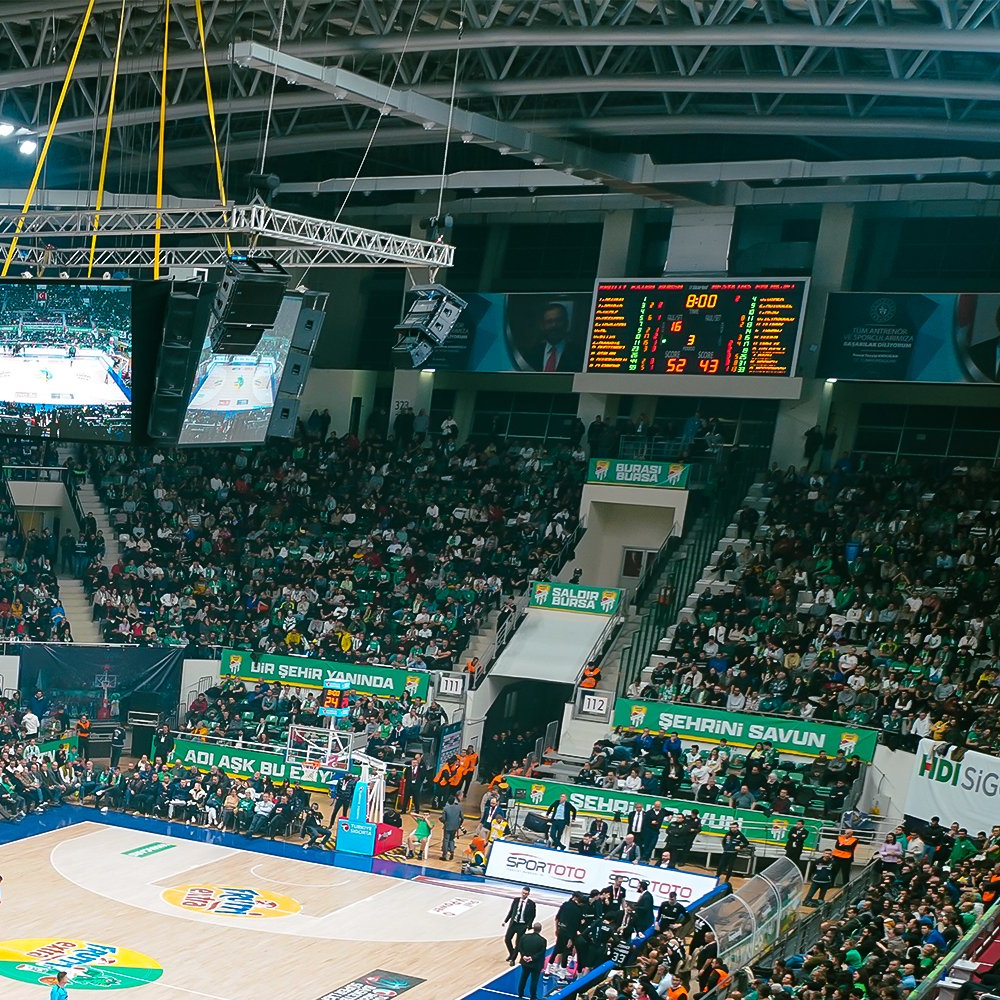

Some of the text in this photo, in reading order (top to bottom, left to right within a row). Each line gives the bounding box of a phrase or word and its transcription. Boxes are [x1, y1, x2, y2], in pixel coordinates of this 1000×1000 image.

[685, 294, 718, 308] 8:00
[686, 334, 695, 346] 3
[666, 358, 686, 372] 52
[699, 359, 719, 373] 43
[616, 463, 662, 474] BURASI
[616, 472, 658, 483] BURSA
[552, 587, 599, 600] SALDIR
[552, 596, 596, 609] BURSA
[325, 669, 394, 690] YANINDA
[445, 680, 458, 691] 111
[324, 697, 339, 708] 24
[585, 696, 604, 711] 112
[748, 724, 826, 748] SAVUN
[184, 749, 214, 765] ADI
[218, 754, 255, 773] AŞK
[260, 761, 285, 777] BU
[919, 754, 961, 786] HDI
[611, 951, 626, 964] 33
